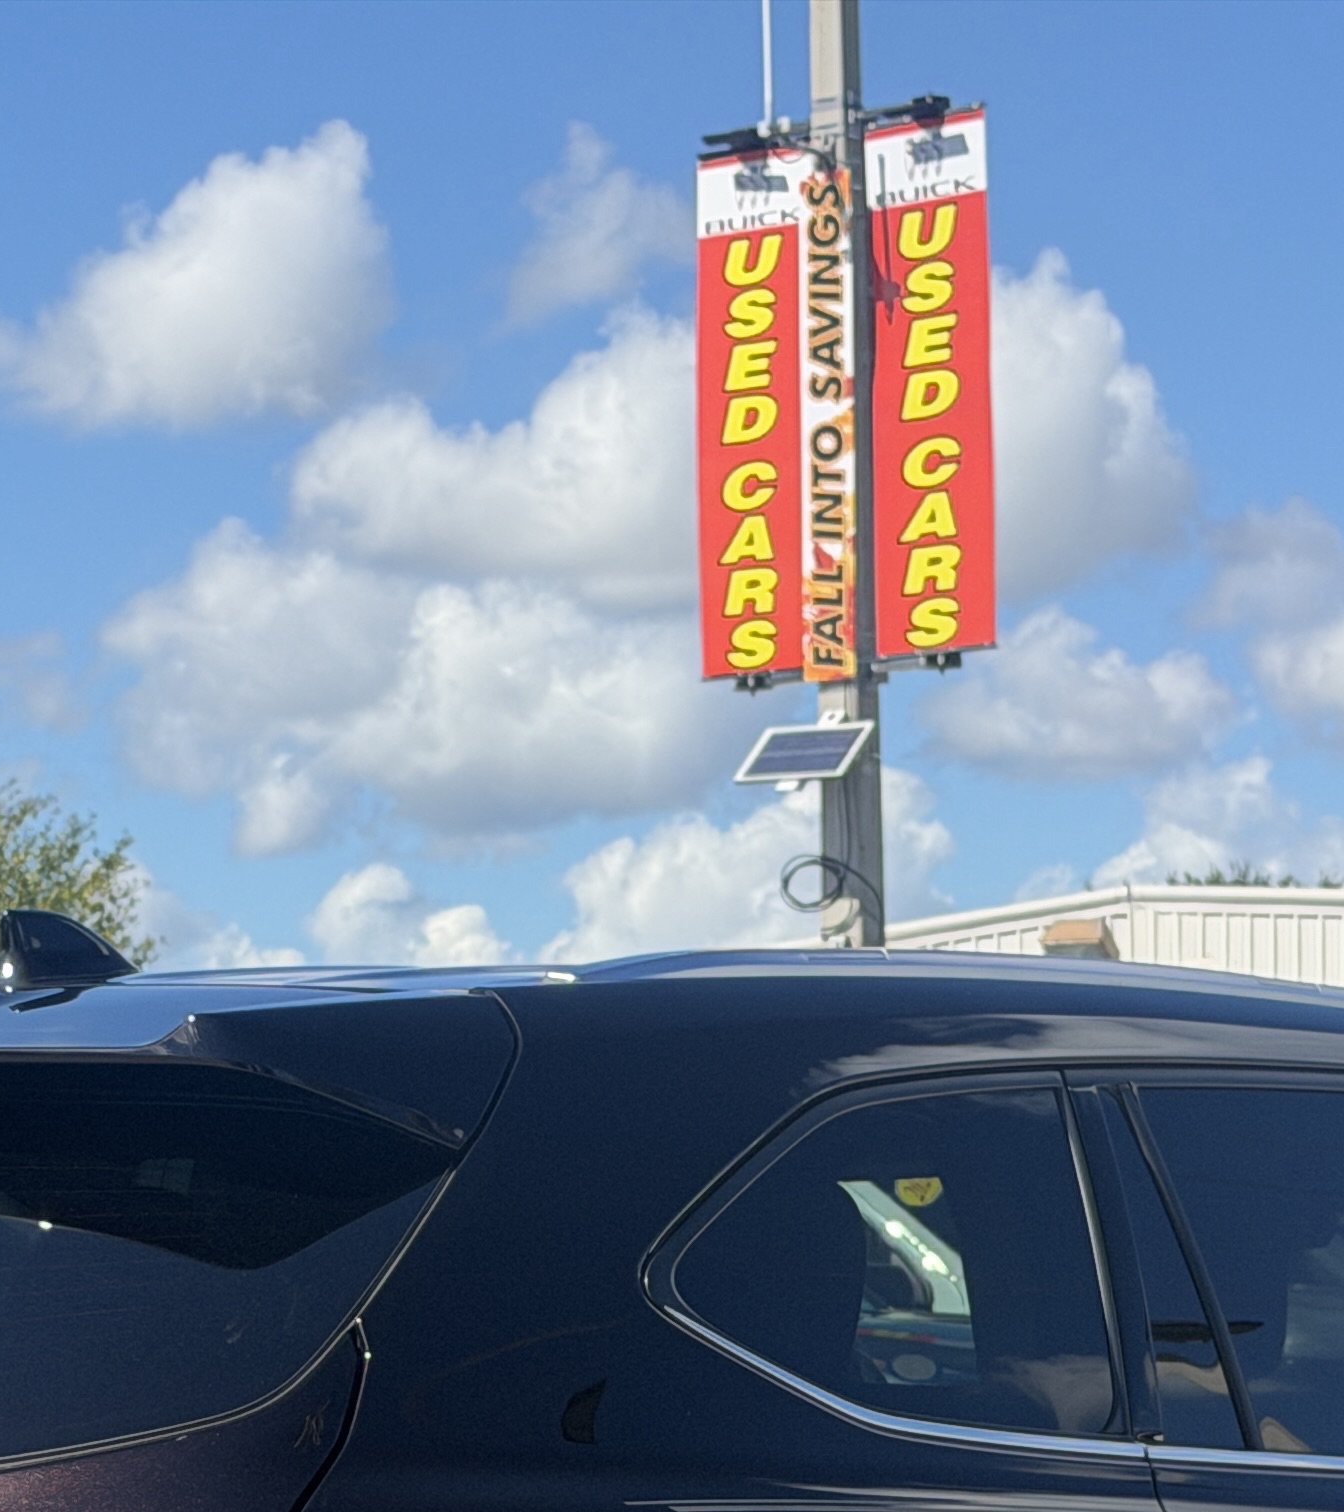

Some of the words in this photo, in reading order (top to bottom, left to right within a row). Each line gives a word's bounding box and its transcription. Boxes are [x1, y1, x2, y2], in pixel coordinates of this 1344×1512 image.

[720, 233, 783, 446] USED
[807, 183, 844, 403] SAVINGS
[897, 202, 961, 423] USED
[718, 460, 779, 669] CARS
[811, 425, 844, 542] INTO
[898, 435, 963, 649] CARS
[812, 563, 844, 667] FALL
